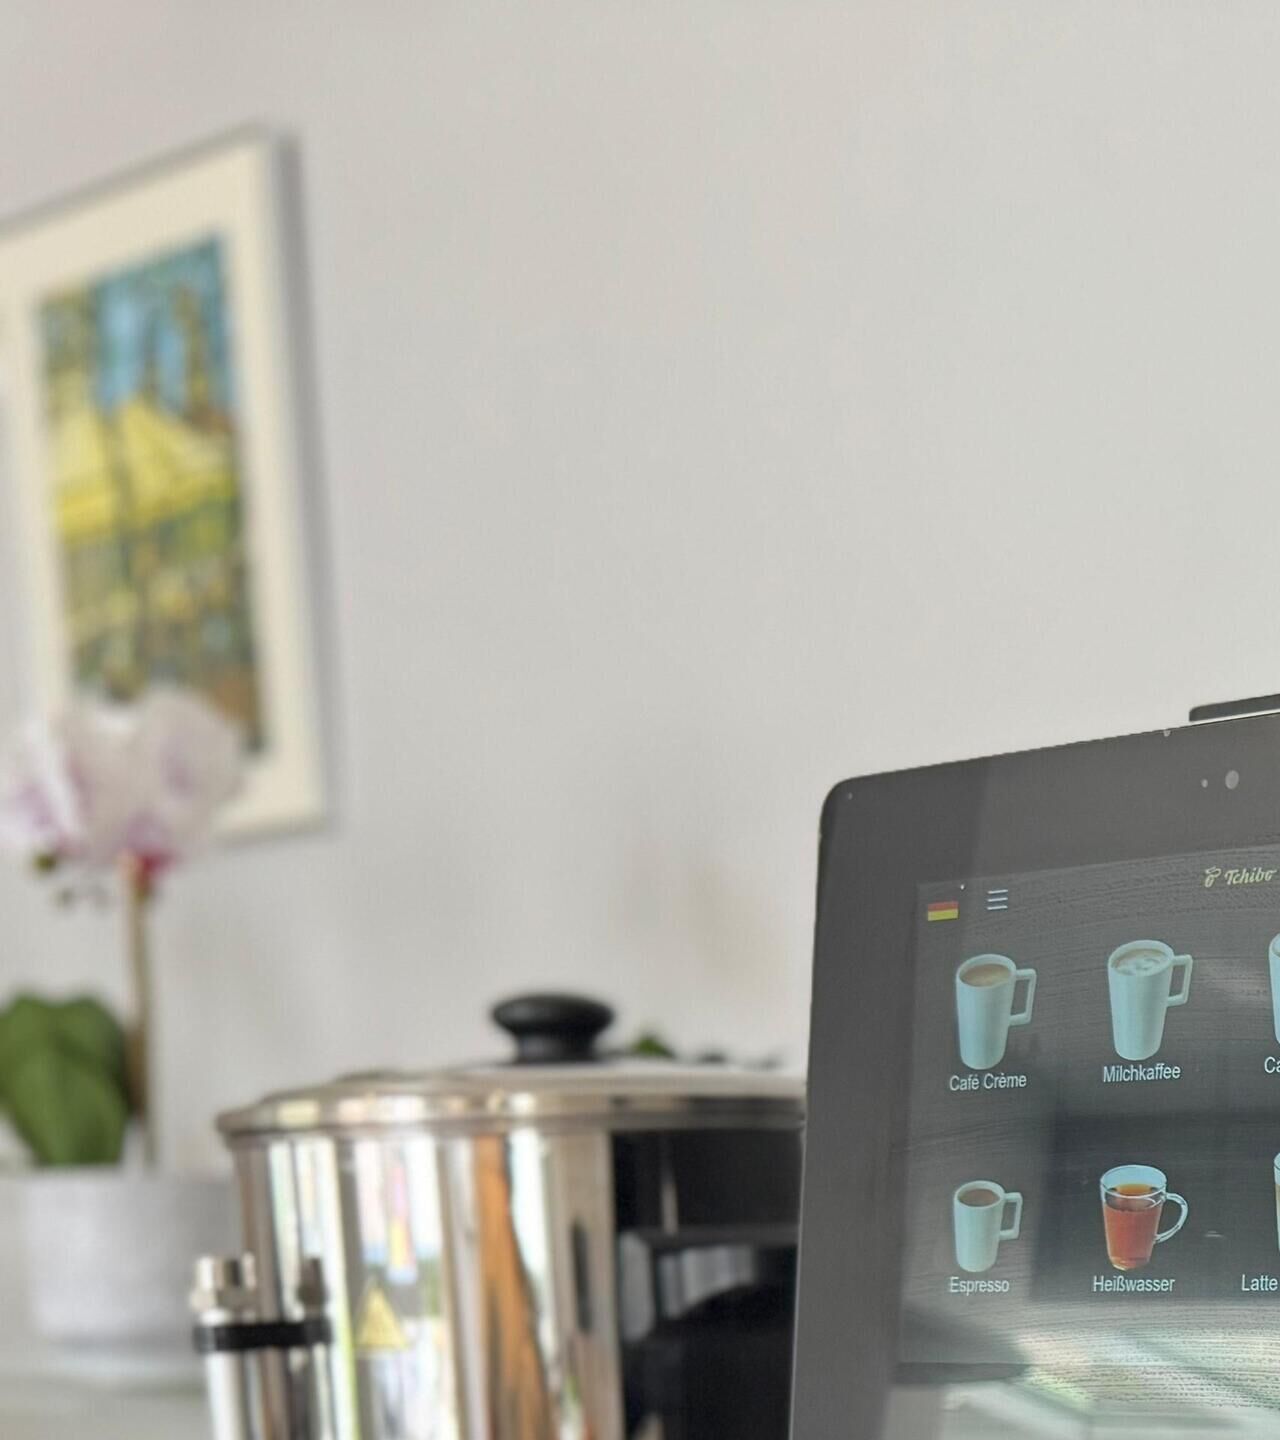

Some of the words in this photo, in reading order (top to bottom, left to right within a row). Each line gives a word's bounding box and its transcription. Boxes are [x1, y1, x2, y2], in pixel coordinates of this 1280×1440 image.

[949, 1074, 980, 1091] Café
[983, 1072, 1027, 1089] Crème
[1103, 1062, 1181, 1083] Milchkaffee
[949, 1276, 1010, 1297] Espresso
[1093, 1275, 1176, 1292] Heißwasser
[1241, 1274, 1278, 1291] Latte
